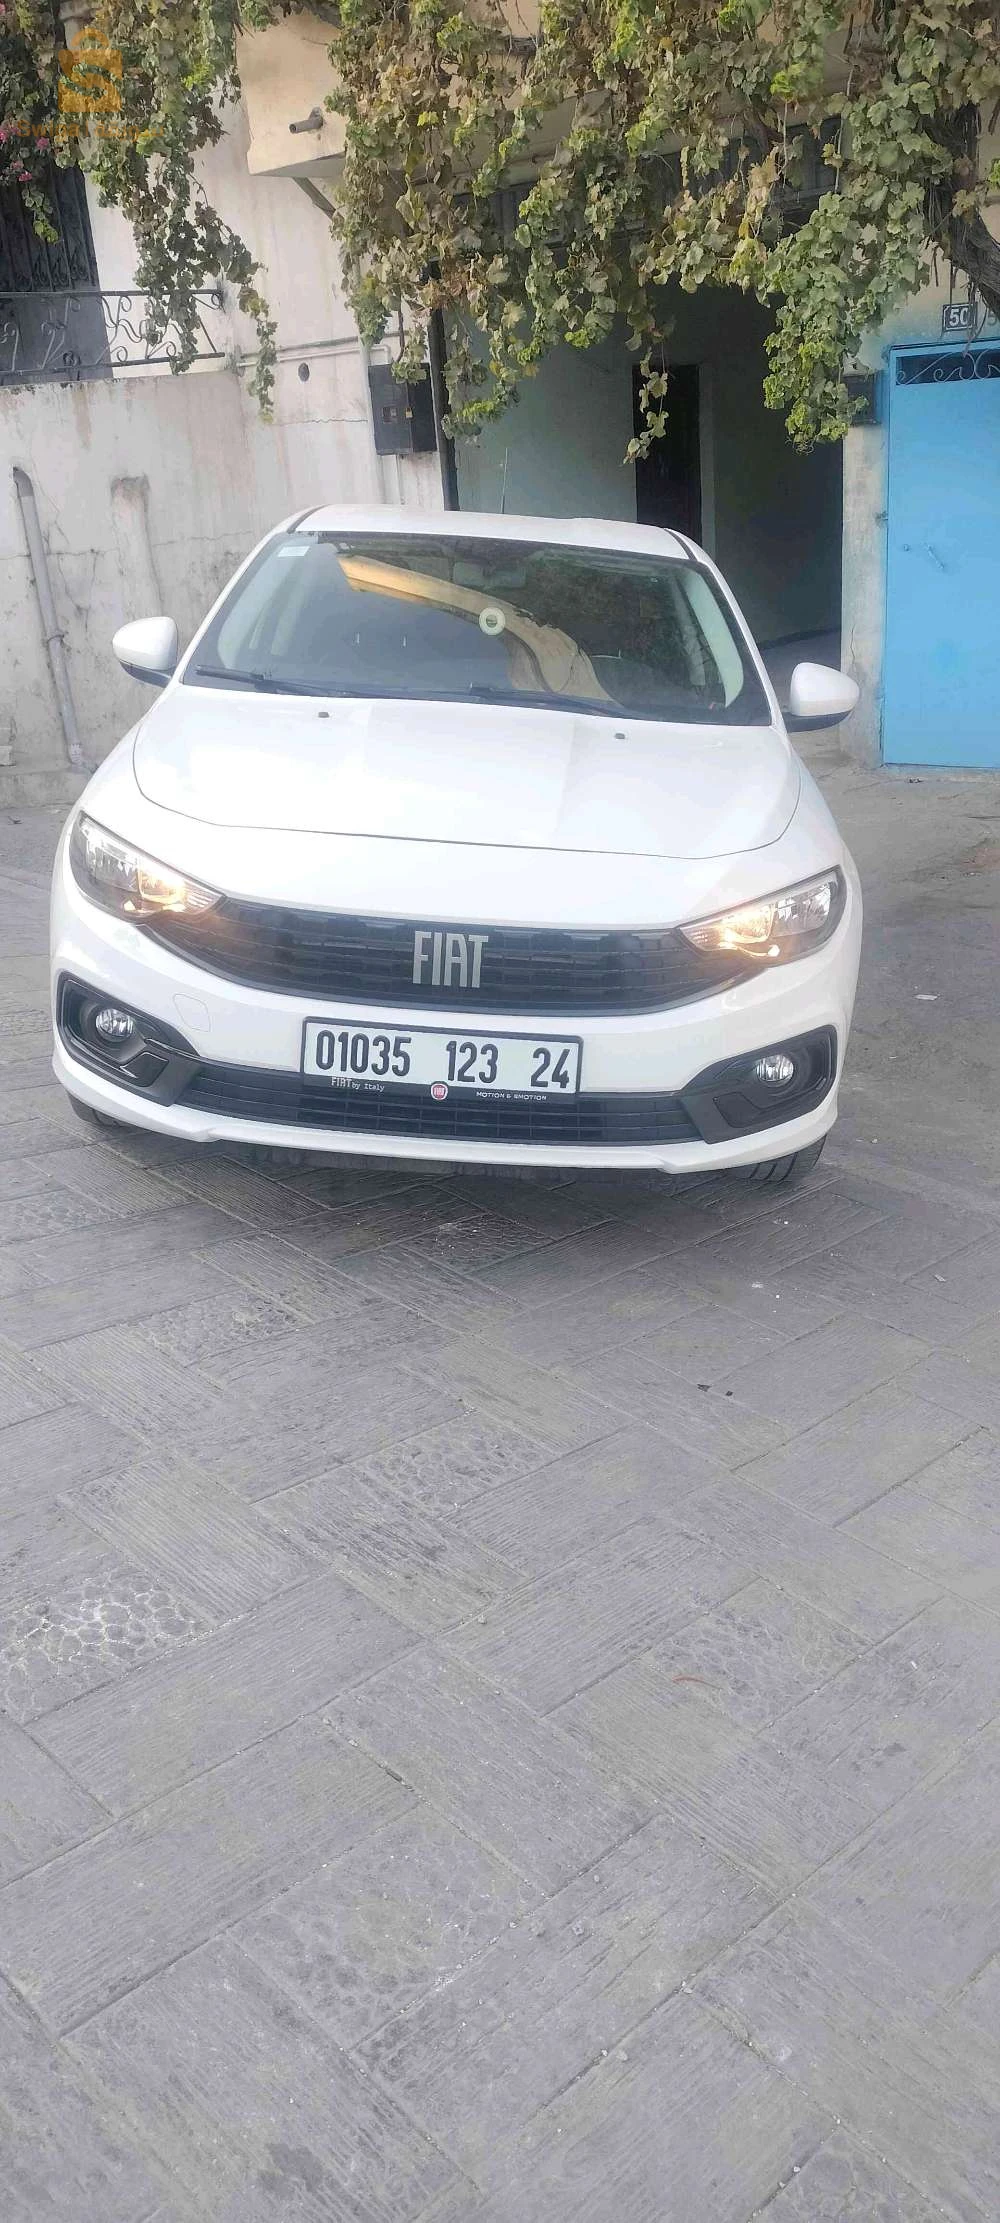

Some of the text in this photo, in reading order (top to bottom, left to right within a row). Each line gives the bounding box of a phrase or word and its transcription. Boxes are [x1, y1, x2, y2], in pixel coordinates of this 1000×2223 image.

[412, 930, 489, 989] FIAT
[316, 1029, 571, 1089] 01035 123 24
[331, 1077, 352, 1088] FIAT
[364, 1083, 385, 1093] Italy
[476, 1091, 505, 1099] MOTION
